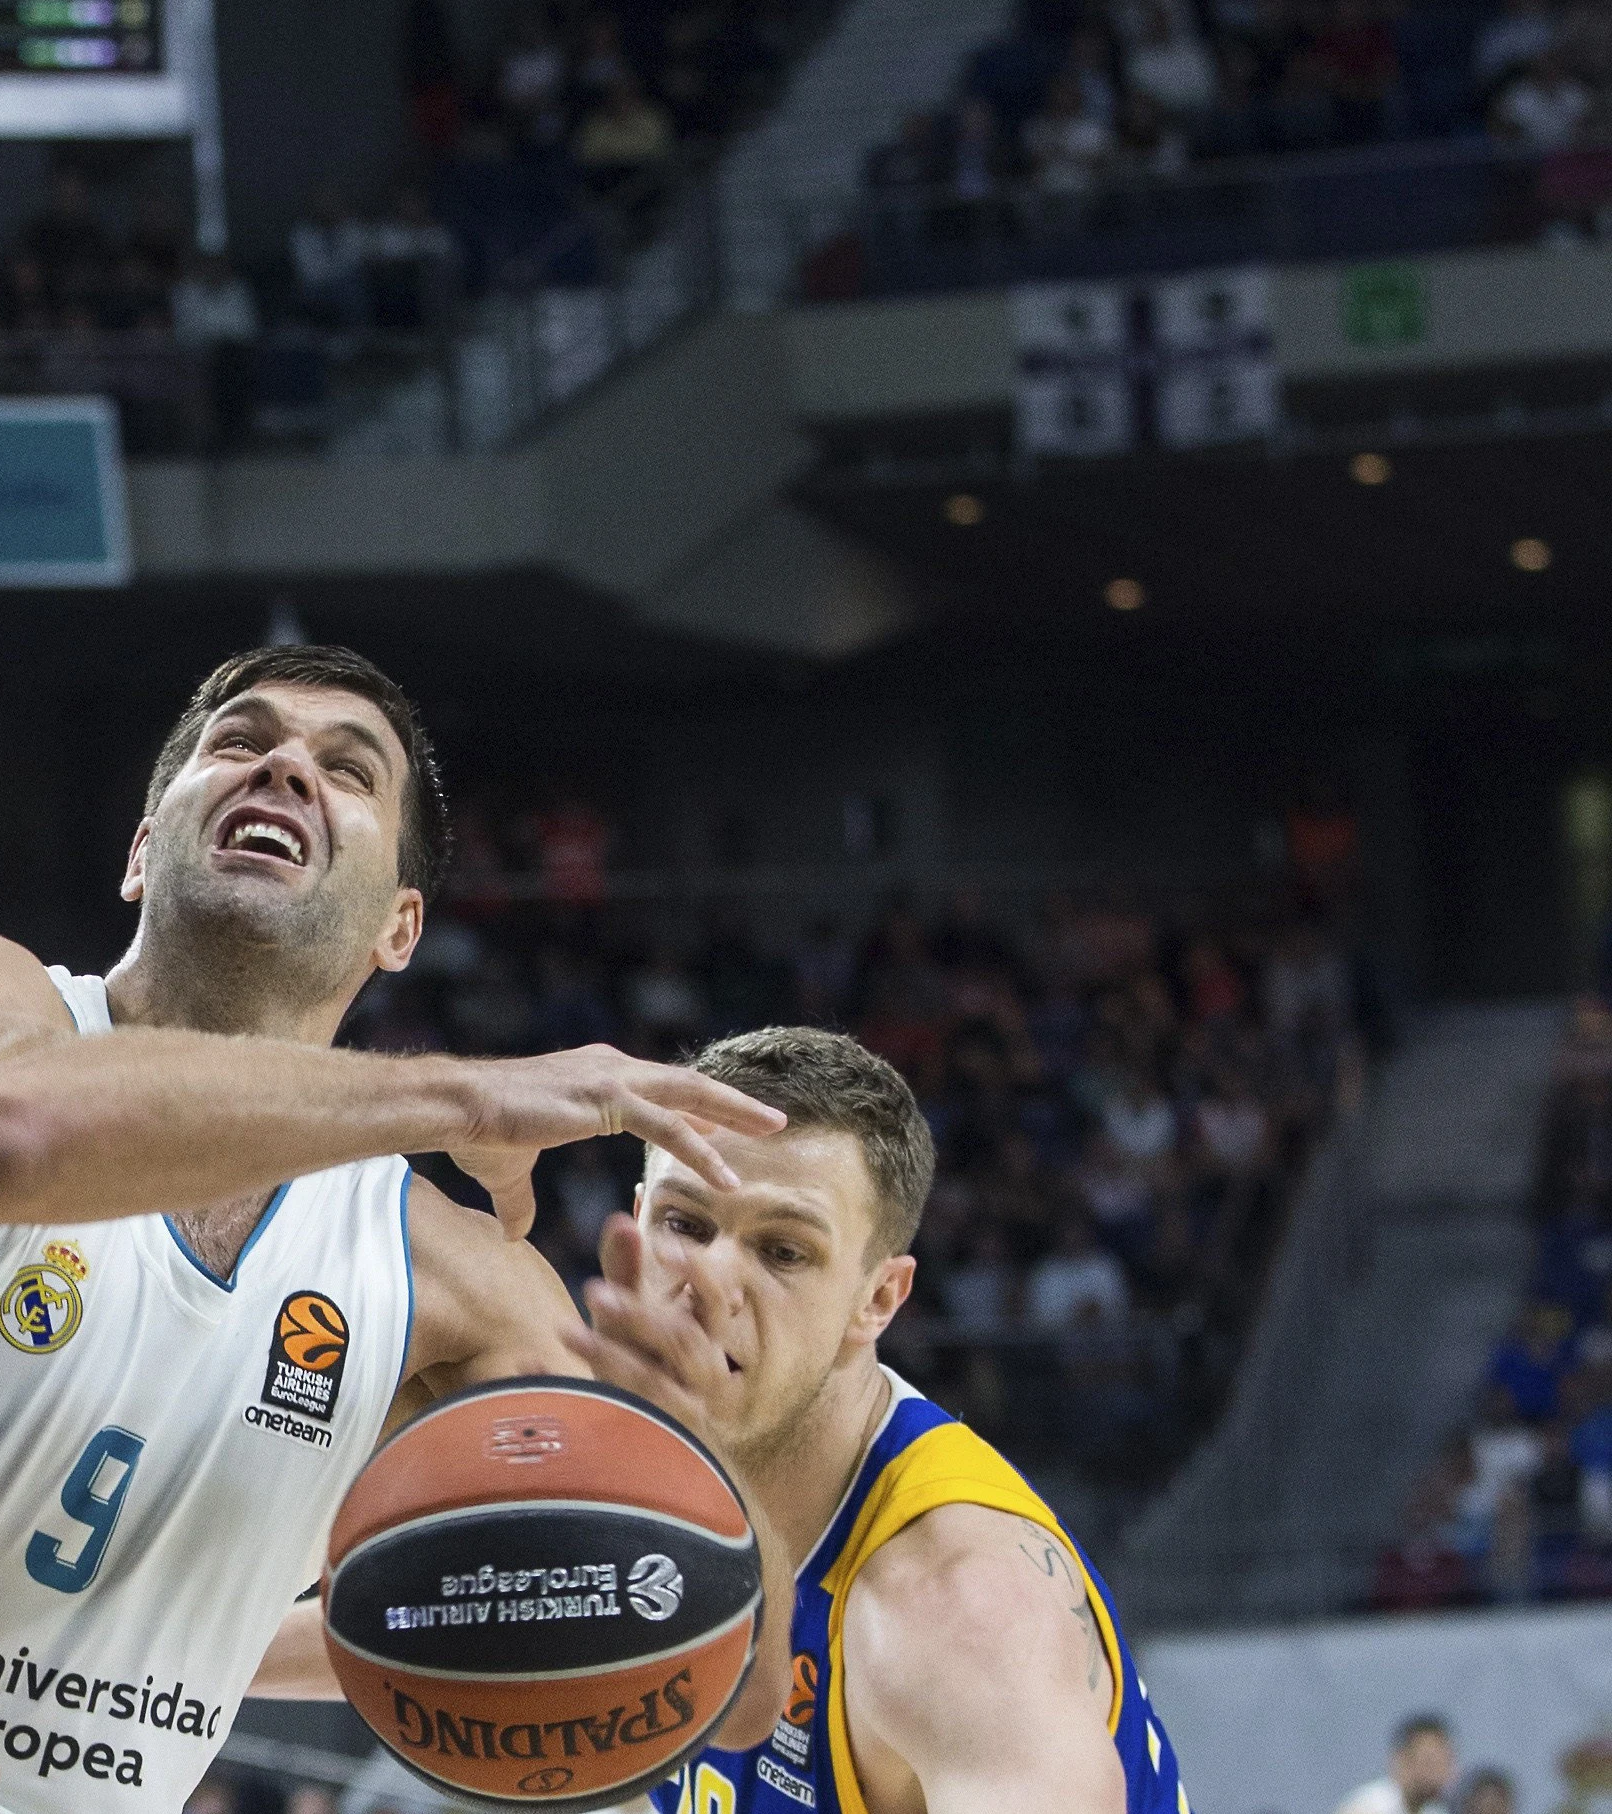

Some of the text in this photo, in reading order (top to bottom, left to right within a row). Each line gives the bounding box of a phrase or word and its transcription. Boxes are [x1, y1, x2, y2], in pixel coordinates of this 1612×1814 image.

[274, 1374, 331, 1402] AIRLINES
[277, 1361, 333, 1390] TURKISH
[245, 1406, 333, 1448] oneteam
[25, 1424, 146, 1594] 9
[440, 1563, 618, 1597] EuroLeague
[384, 1592, 622, 1630] TURKISH AIRLINES
[390, 1668, 695, 1761] SPALDING
